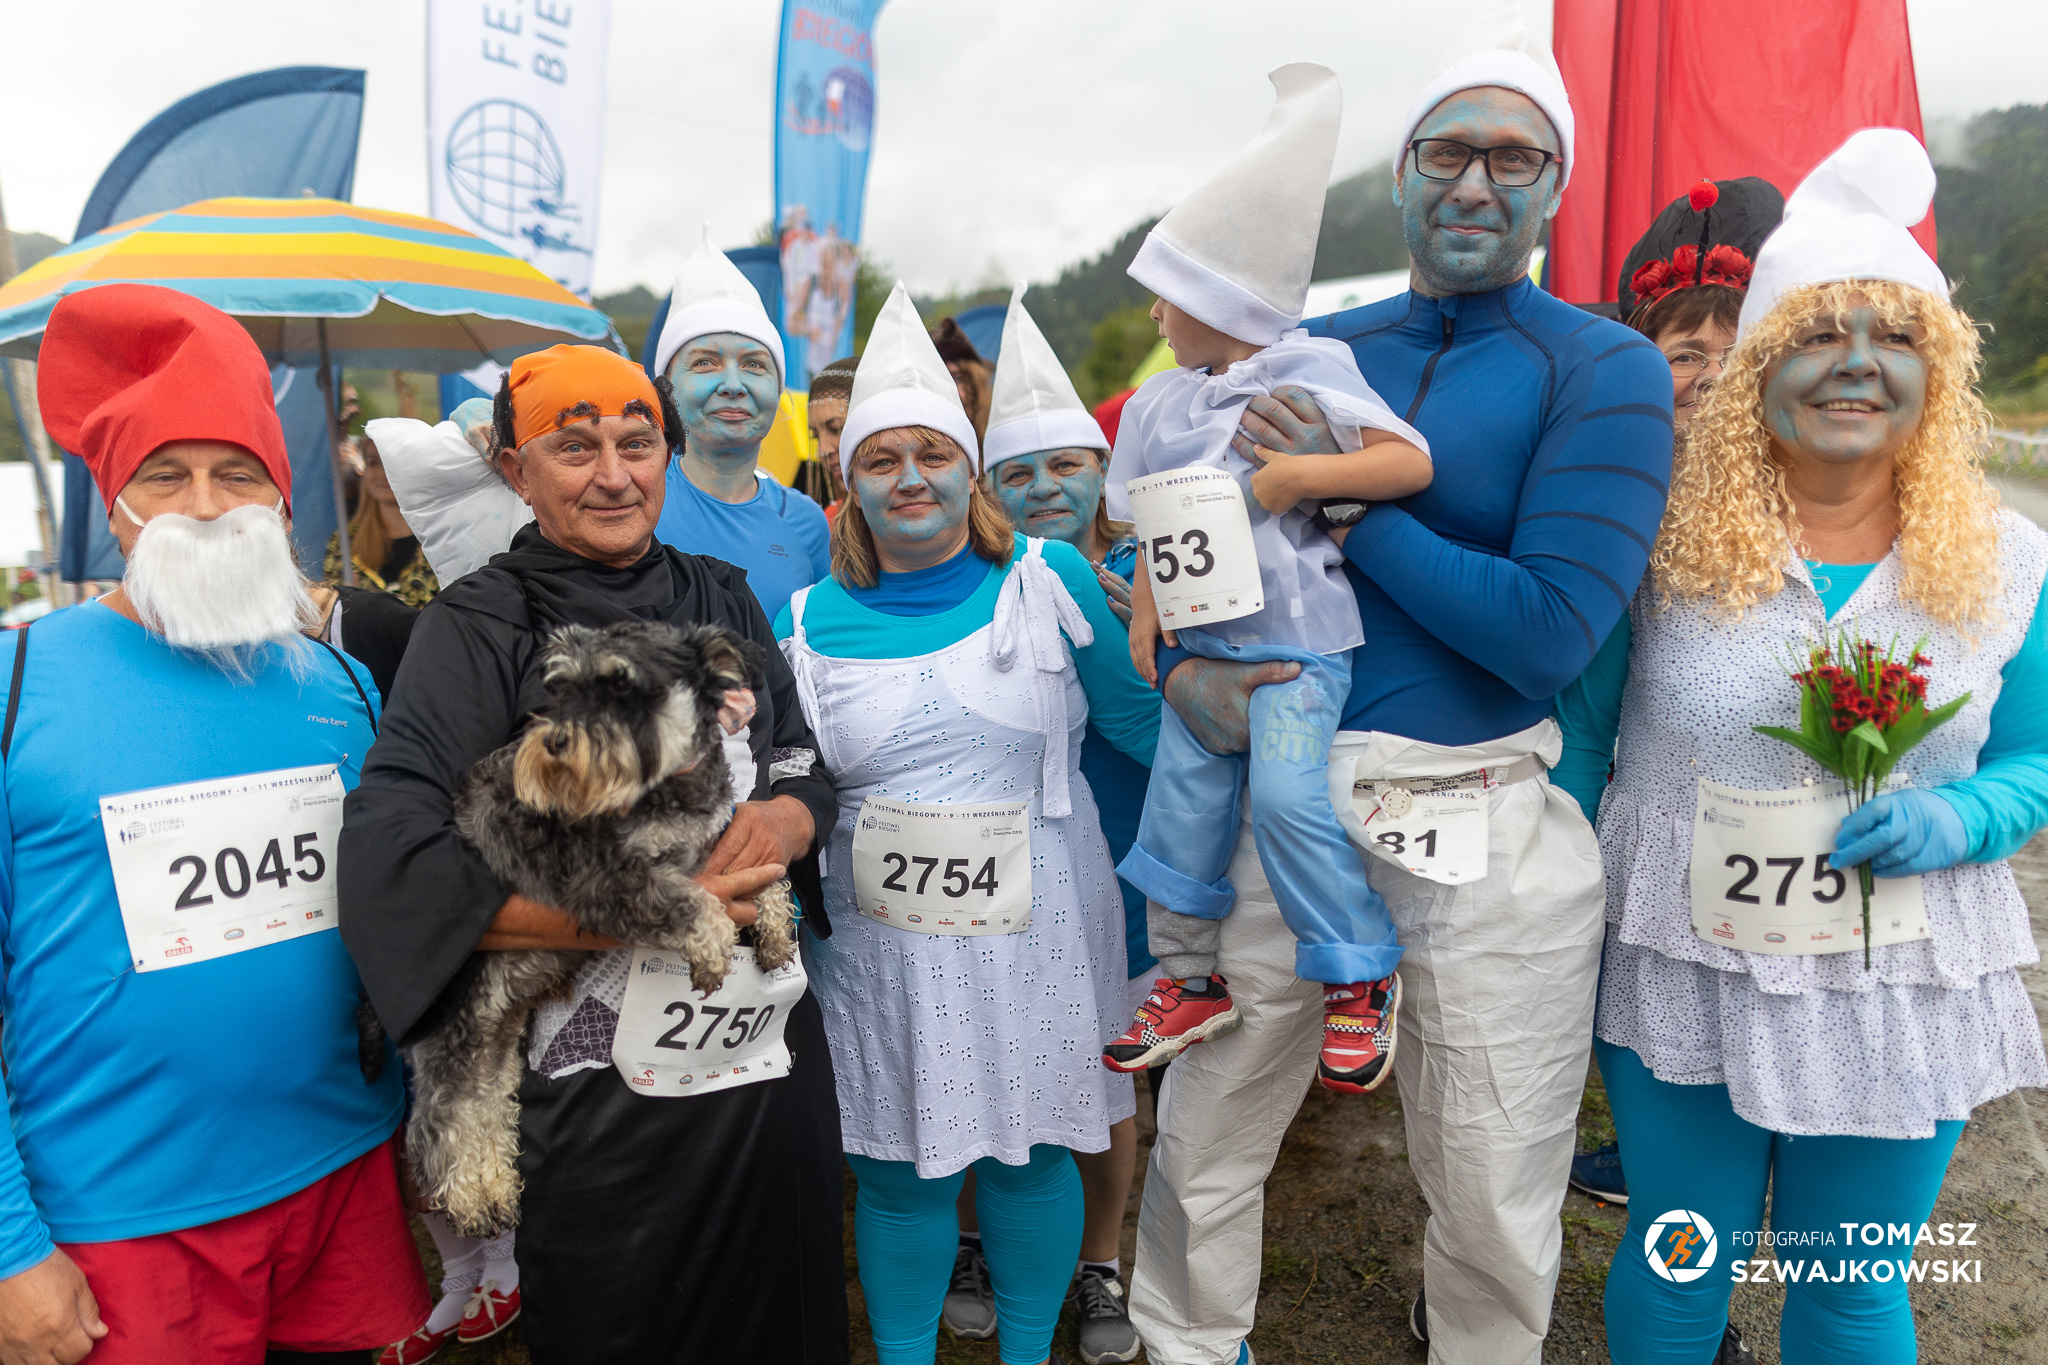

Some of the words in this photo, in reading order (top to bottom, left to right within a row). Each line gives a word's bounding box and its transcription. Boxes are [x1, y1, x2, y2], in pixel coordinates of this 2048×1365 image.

[482, 0, 523, 69] FE
[1166, 474, 1209, 486] WRZEŚNIA
[307, 715, 348, 728] martes
[1260, 730, 1322, 765] CITY
[134, 797, 186, 811] FESTIWAL
[190, 789, 233, 801] BIEGOWY
[271, 776, 313, 788] WRZEŚNIA
[315, 774, 332, 782] 2022
[1409, 784, 1460, 796] ino-active
[1754, 798, 1802, 808] BIEGOWY
[875, 804, 905, 815] FESTIWAL
[907, 810, 941, 818] BIEGOWY
[972, 810, 1006, 818] WRZEŚNIA
[149, 818, 185, 829] FESTIWAL
[150, 824, 186, 835] BIEGOWY
[878, 820, 900, 829] FESTIWAL
[1374, 829, 1437, 858] 81
[168, 831, 326, 912] 2045
[881, 852, 999, 898] 2754
[1724, 853, 1875, 906] 275
[665, 969, 690, 977] BIEGOW
[666, 963, 691, 972] FESTIWA
[654, 1001, 776, 1051] 2750
[633, 1076, 655, 1086] ORLEN
